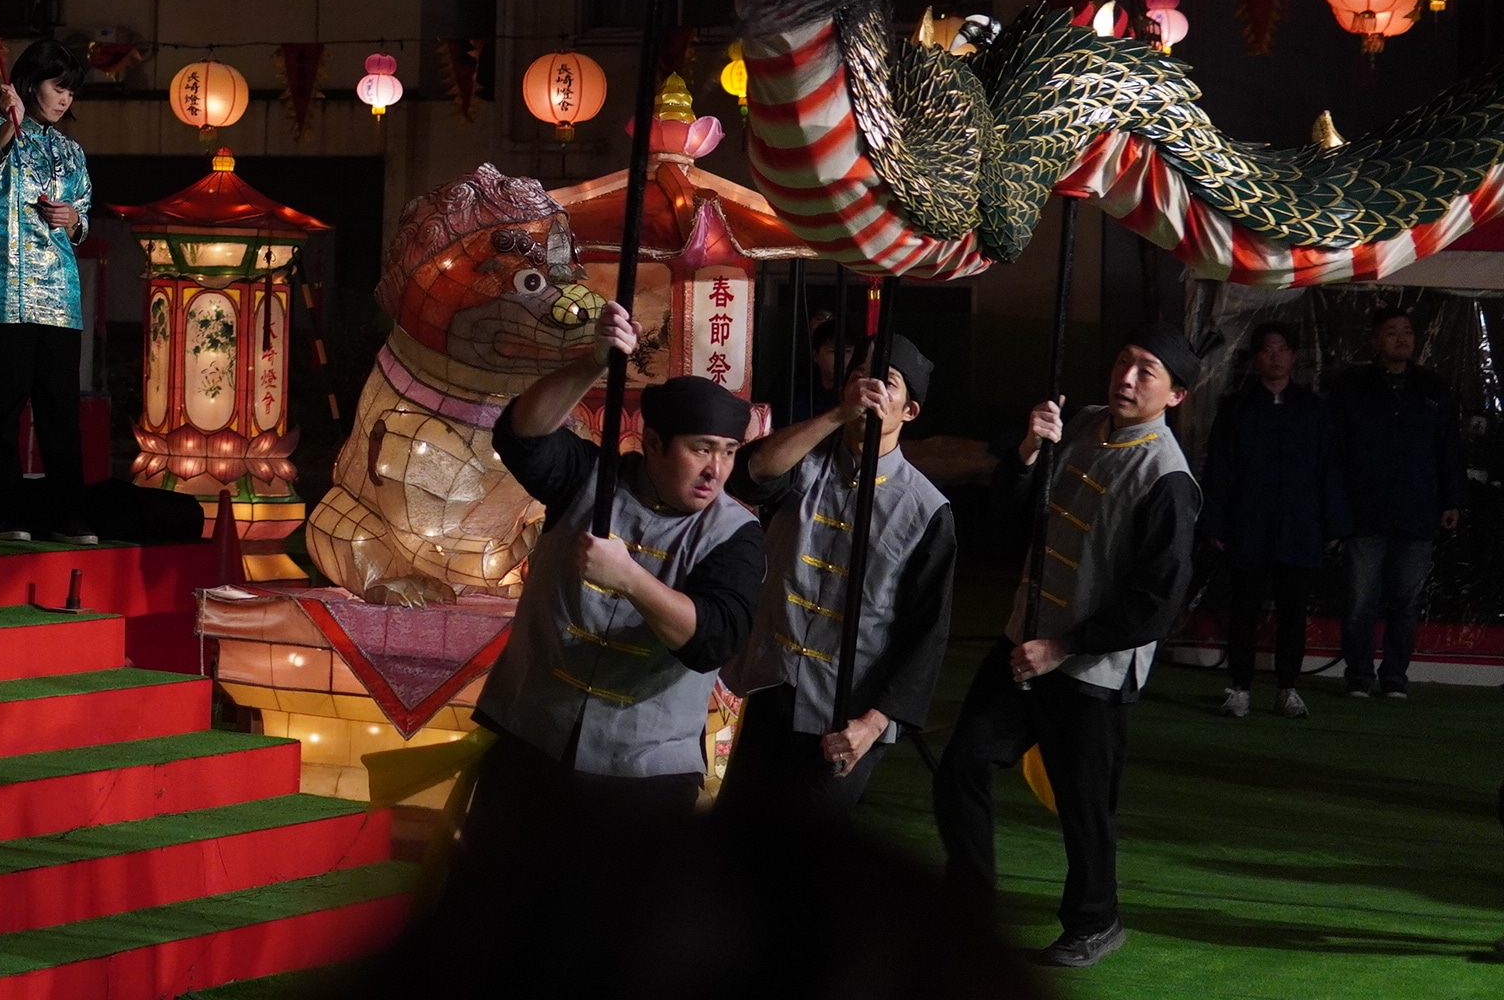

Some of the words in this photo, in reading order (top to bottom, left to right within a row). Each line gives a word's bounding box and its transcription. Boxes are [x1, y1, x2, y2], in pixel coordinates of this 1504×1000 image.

[556, 63, 574, 112] 長崎燈會
[706, 275, 735, 384] 春節祭
